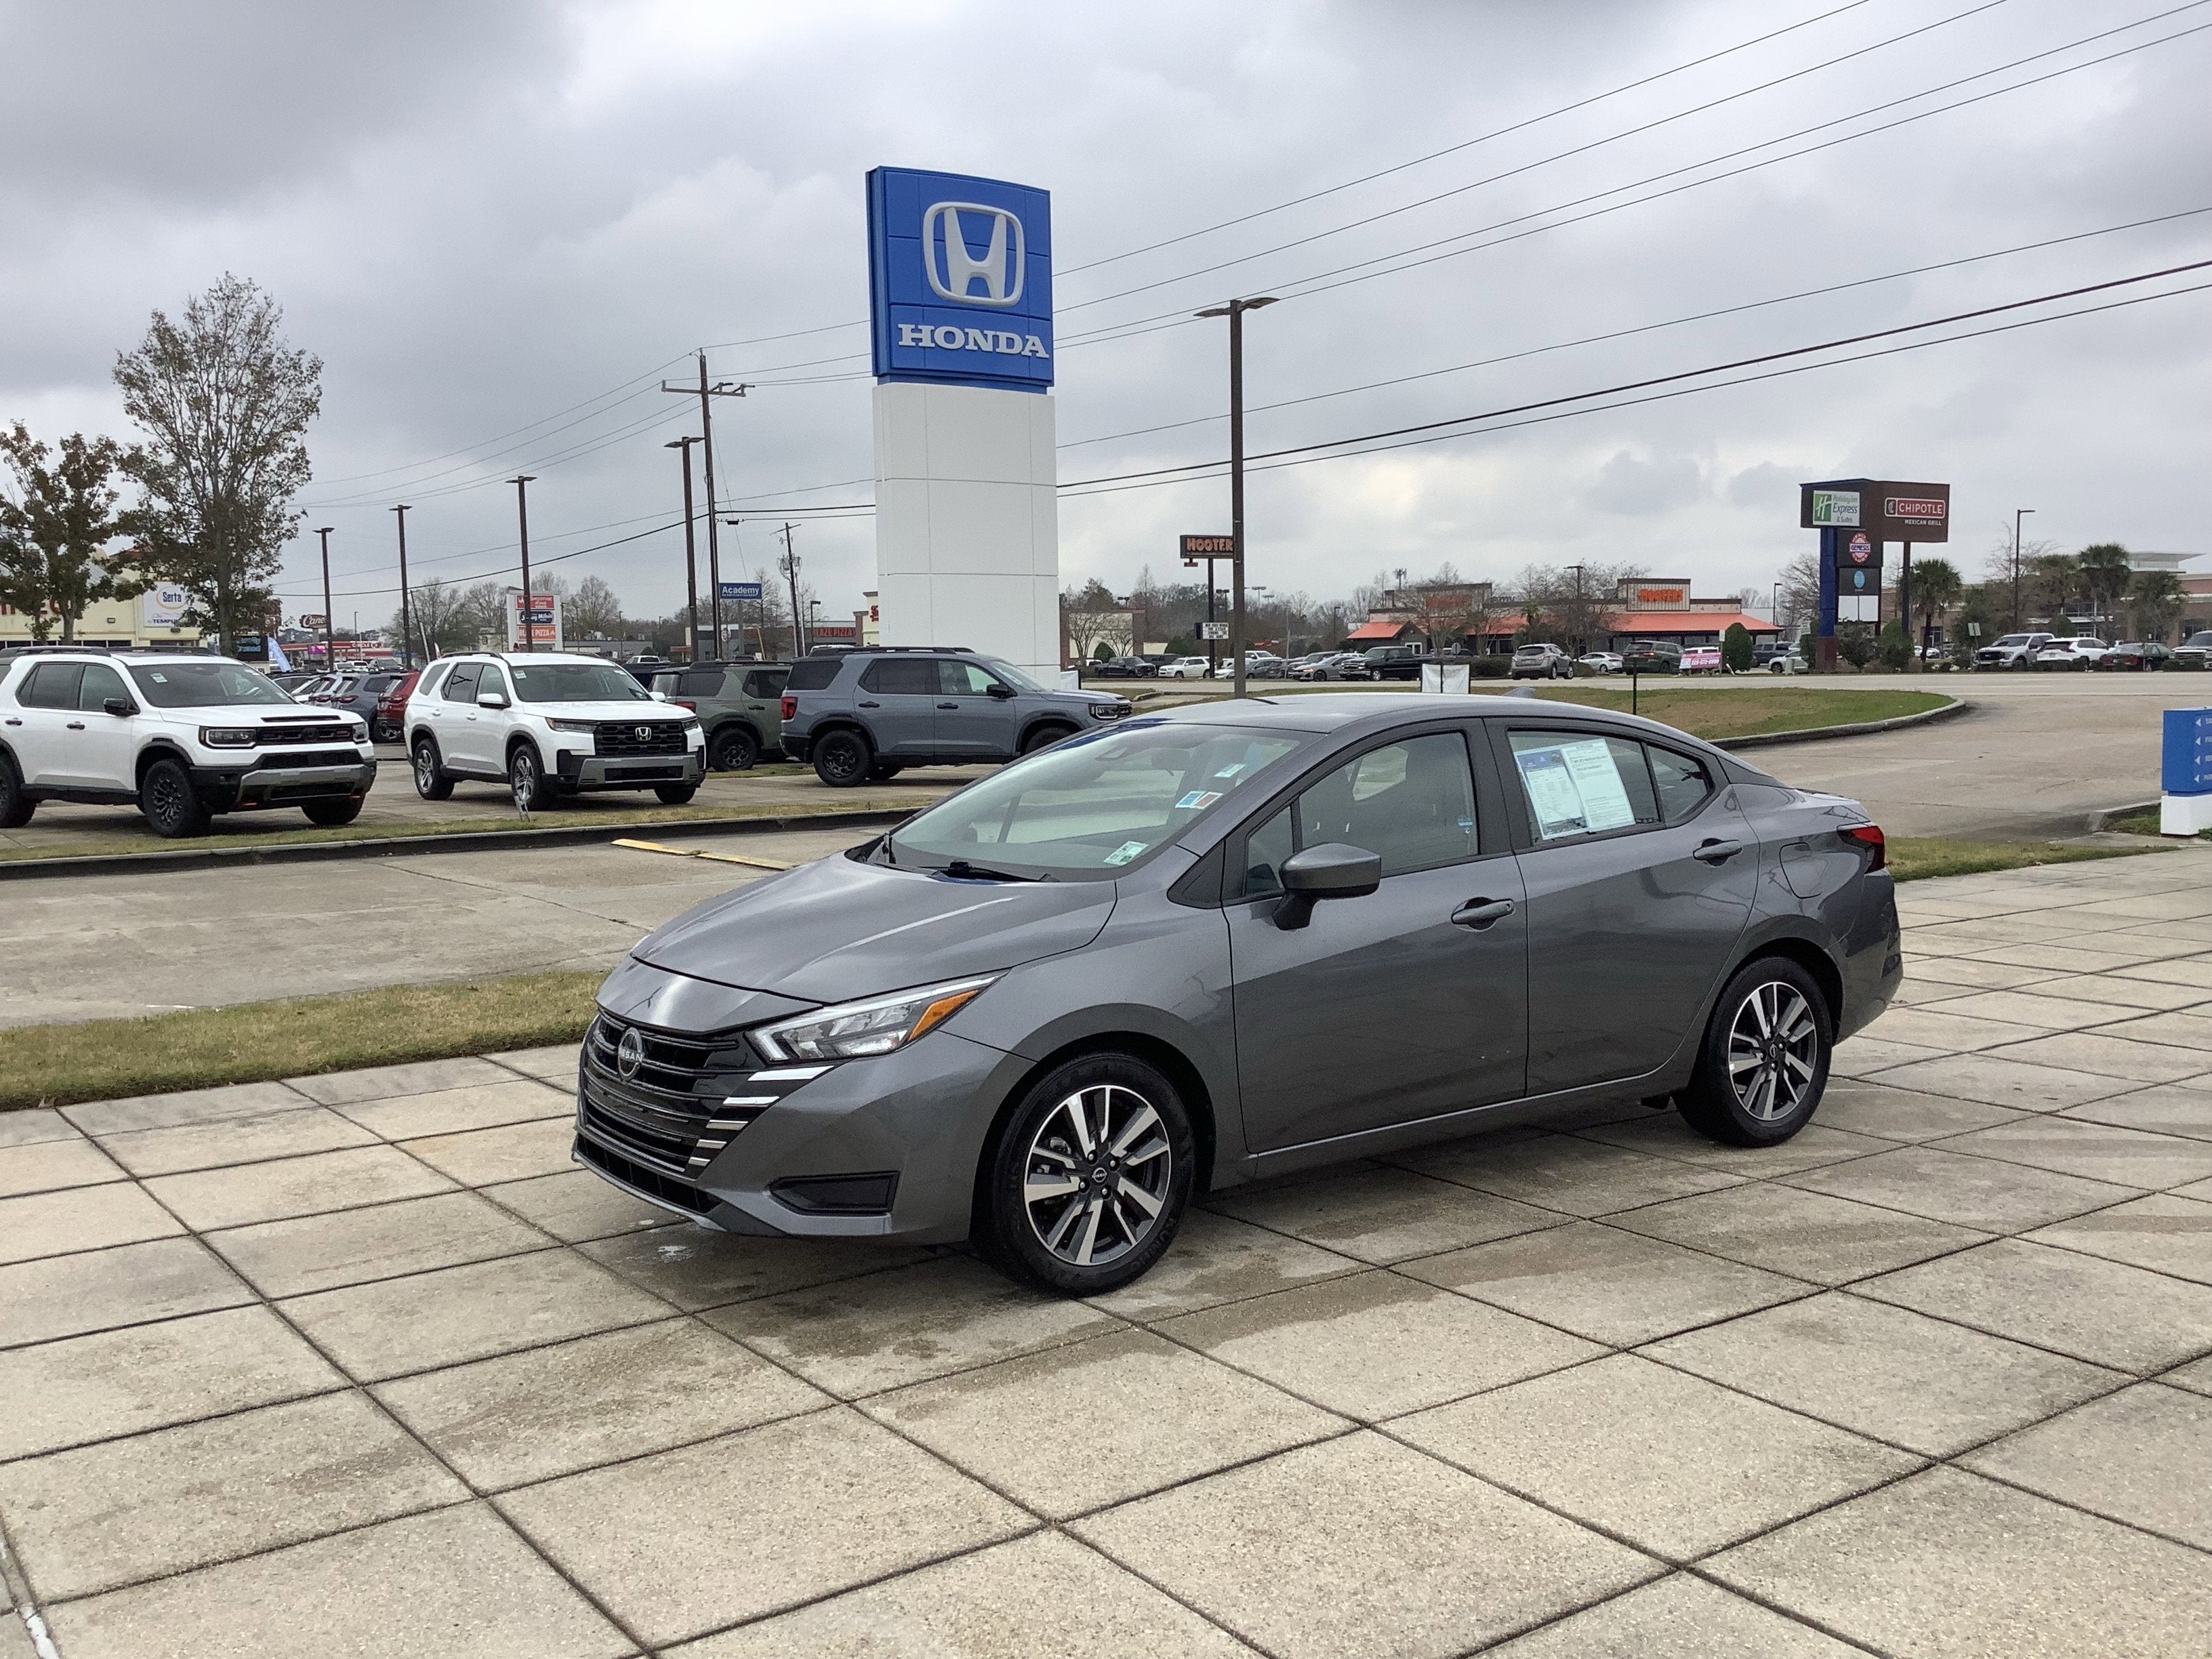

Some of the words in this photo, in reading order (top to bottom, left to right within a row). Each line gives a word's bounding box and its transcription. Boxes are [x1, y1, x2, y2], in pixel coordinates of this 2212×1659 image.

[898, 324, 1049, 359] HONDA
[1832, 503, 1858, 515] Express
[1898, 503, 1943, 514] CHIPOTLE
[1186, 537, 1233, 552] HOOTER
[163, 592, 182, 602] Serta
[722, 586, 760, 596] Academy
[302, 615, 325, 628] Cane
